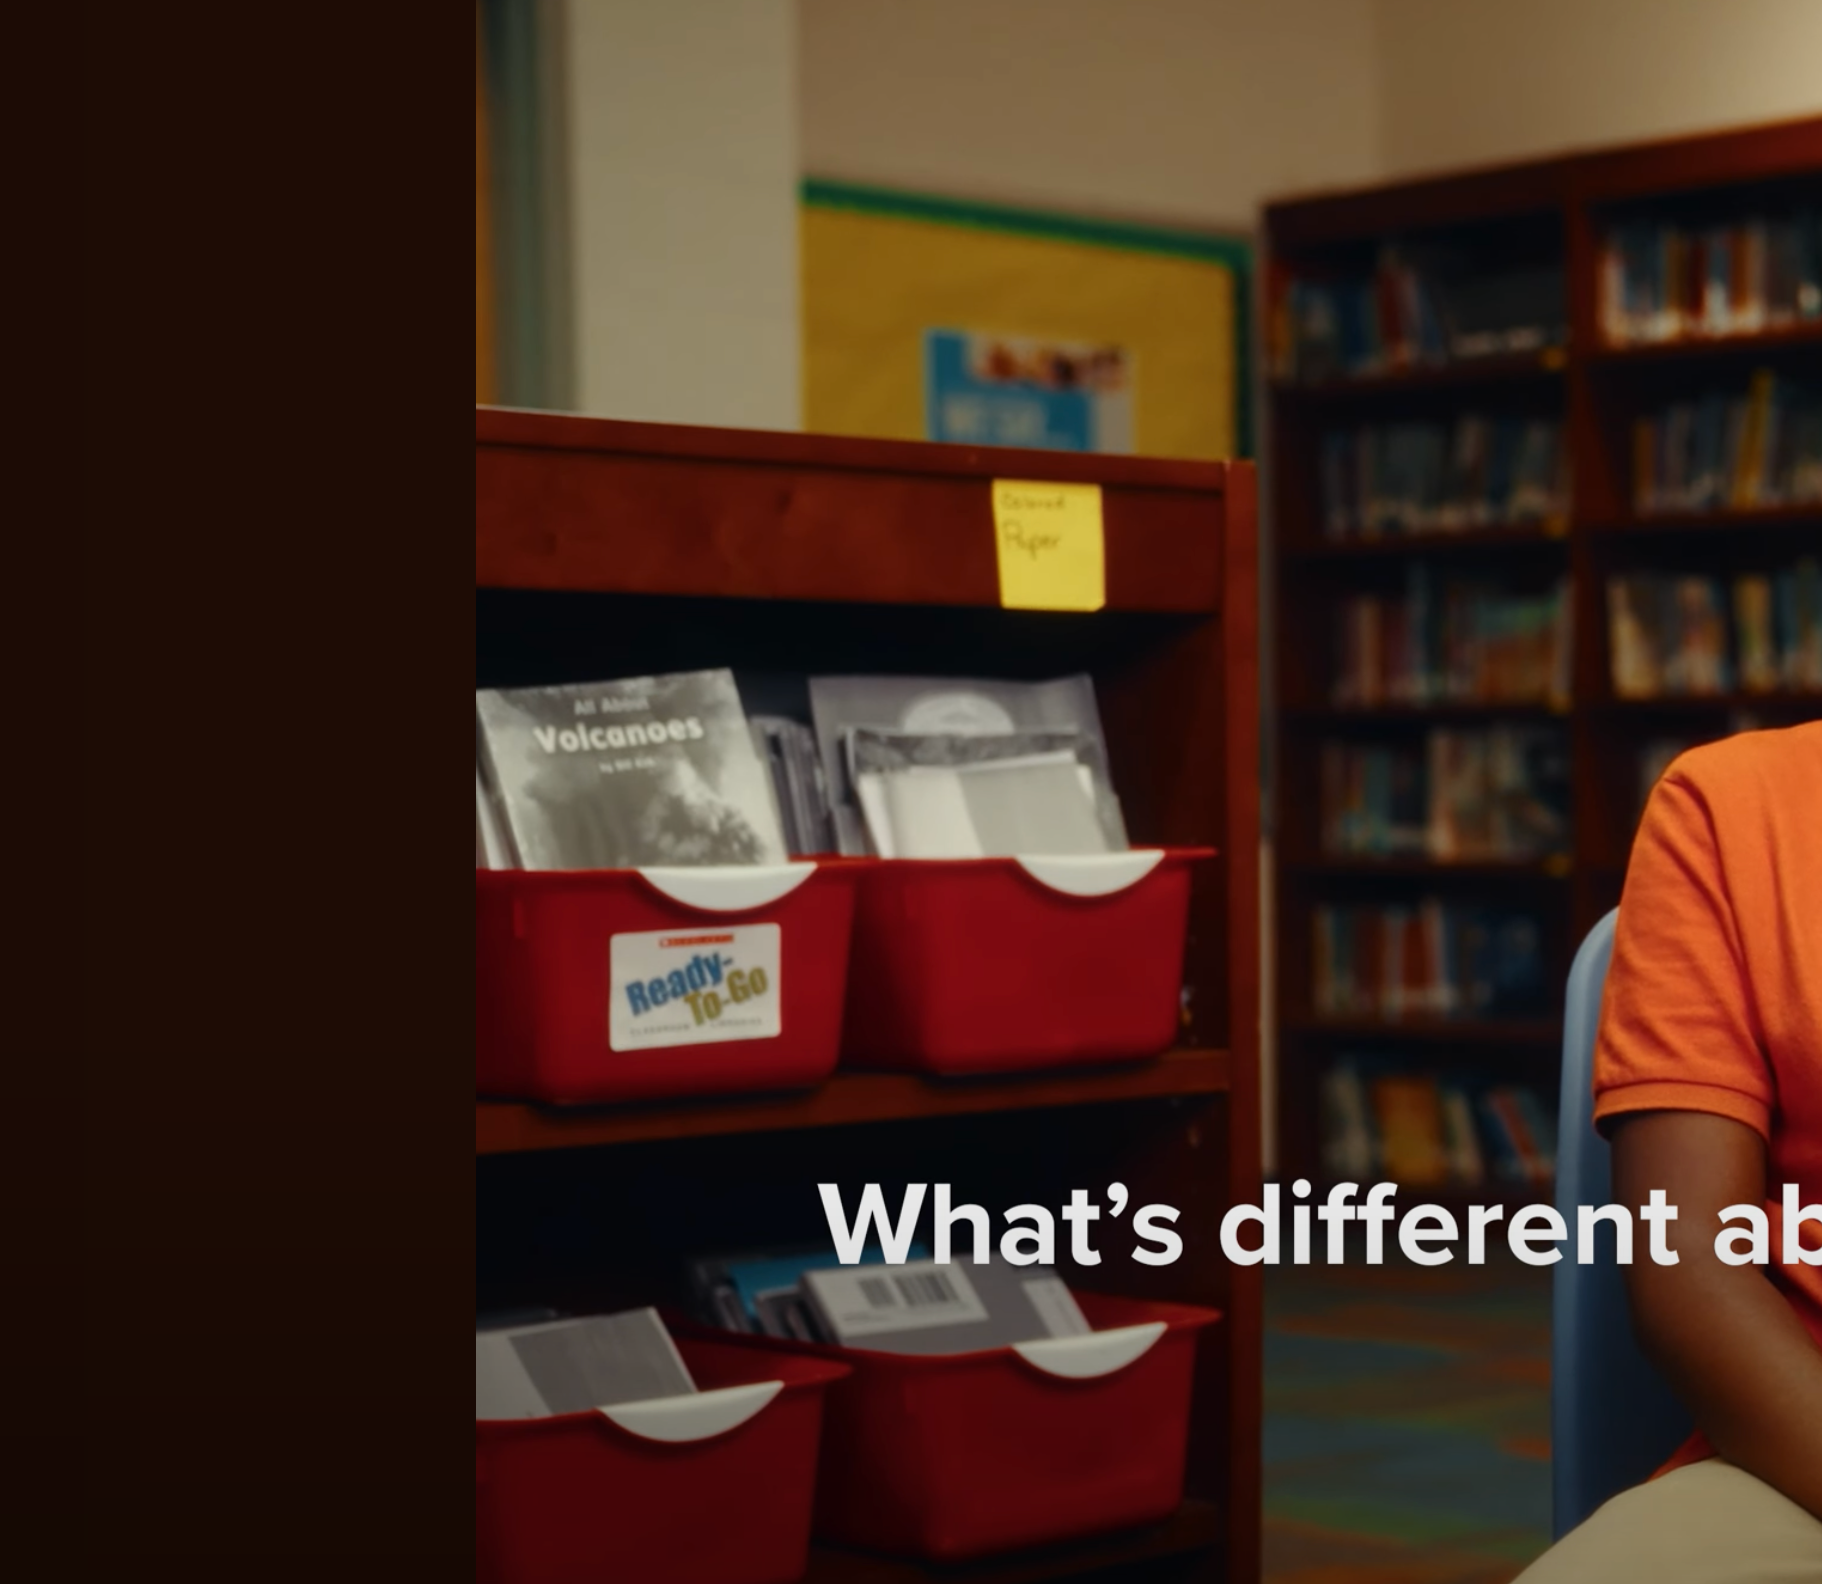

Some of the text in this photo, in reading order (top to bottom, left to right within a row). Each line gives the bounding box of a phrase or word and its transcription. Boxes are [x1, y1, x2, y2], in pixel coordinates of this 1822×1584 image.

[1002, 519, 1060, 562] Paper
[574, 695, 650, 715] All About
[532, 716, 704, 754] Volcanoes
[625, 952, 734, 1017] Ready-
[683, 966, 769, 1026] To-Go
